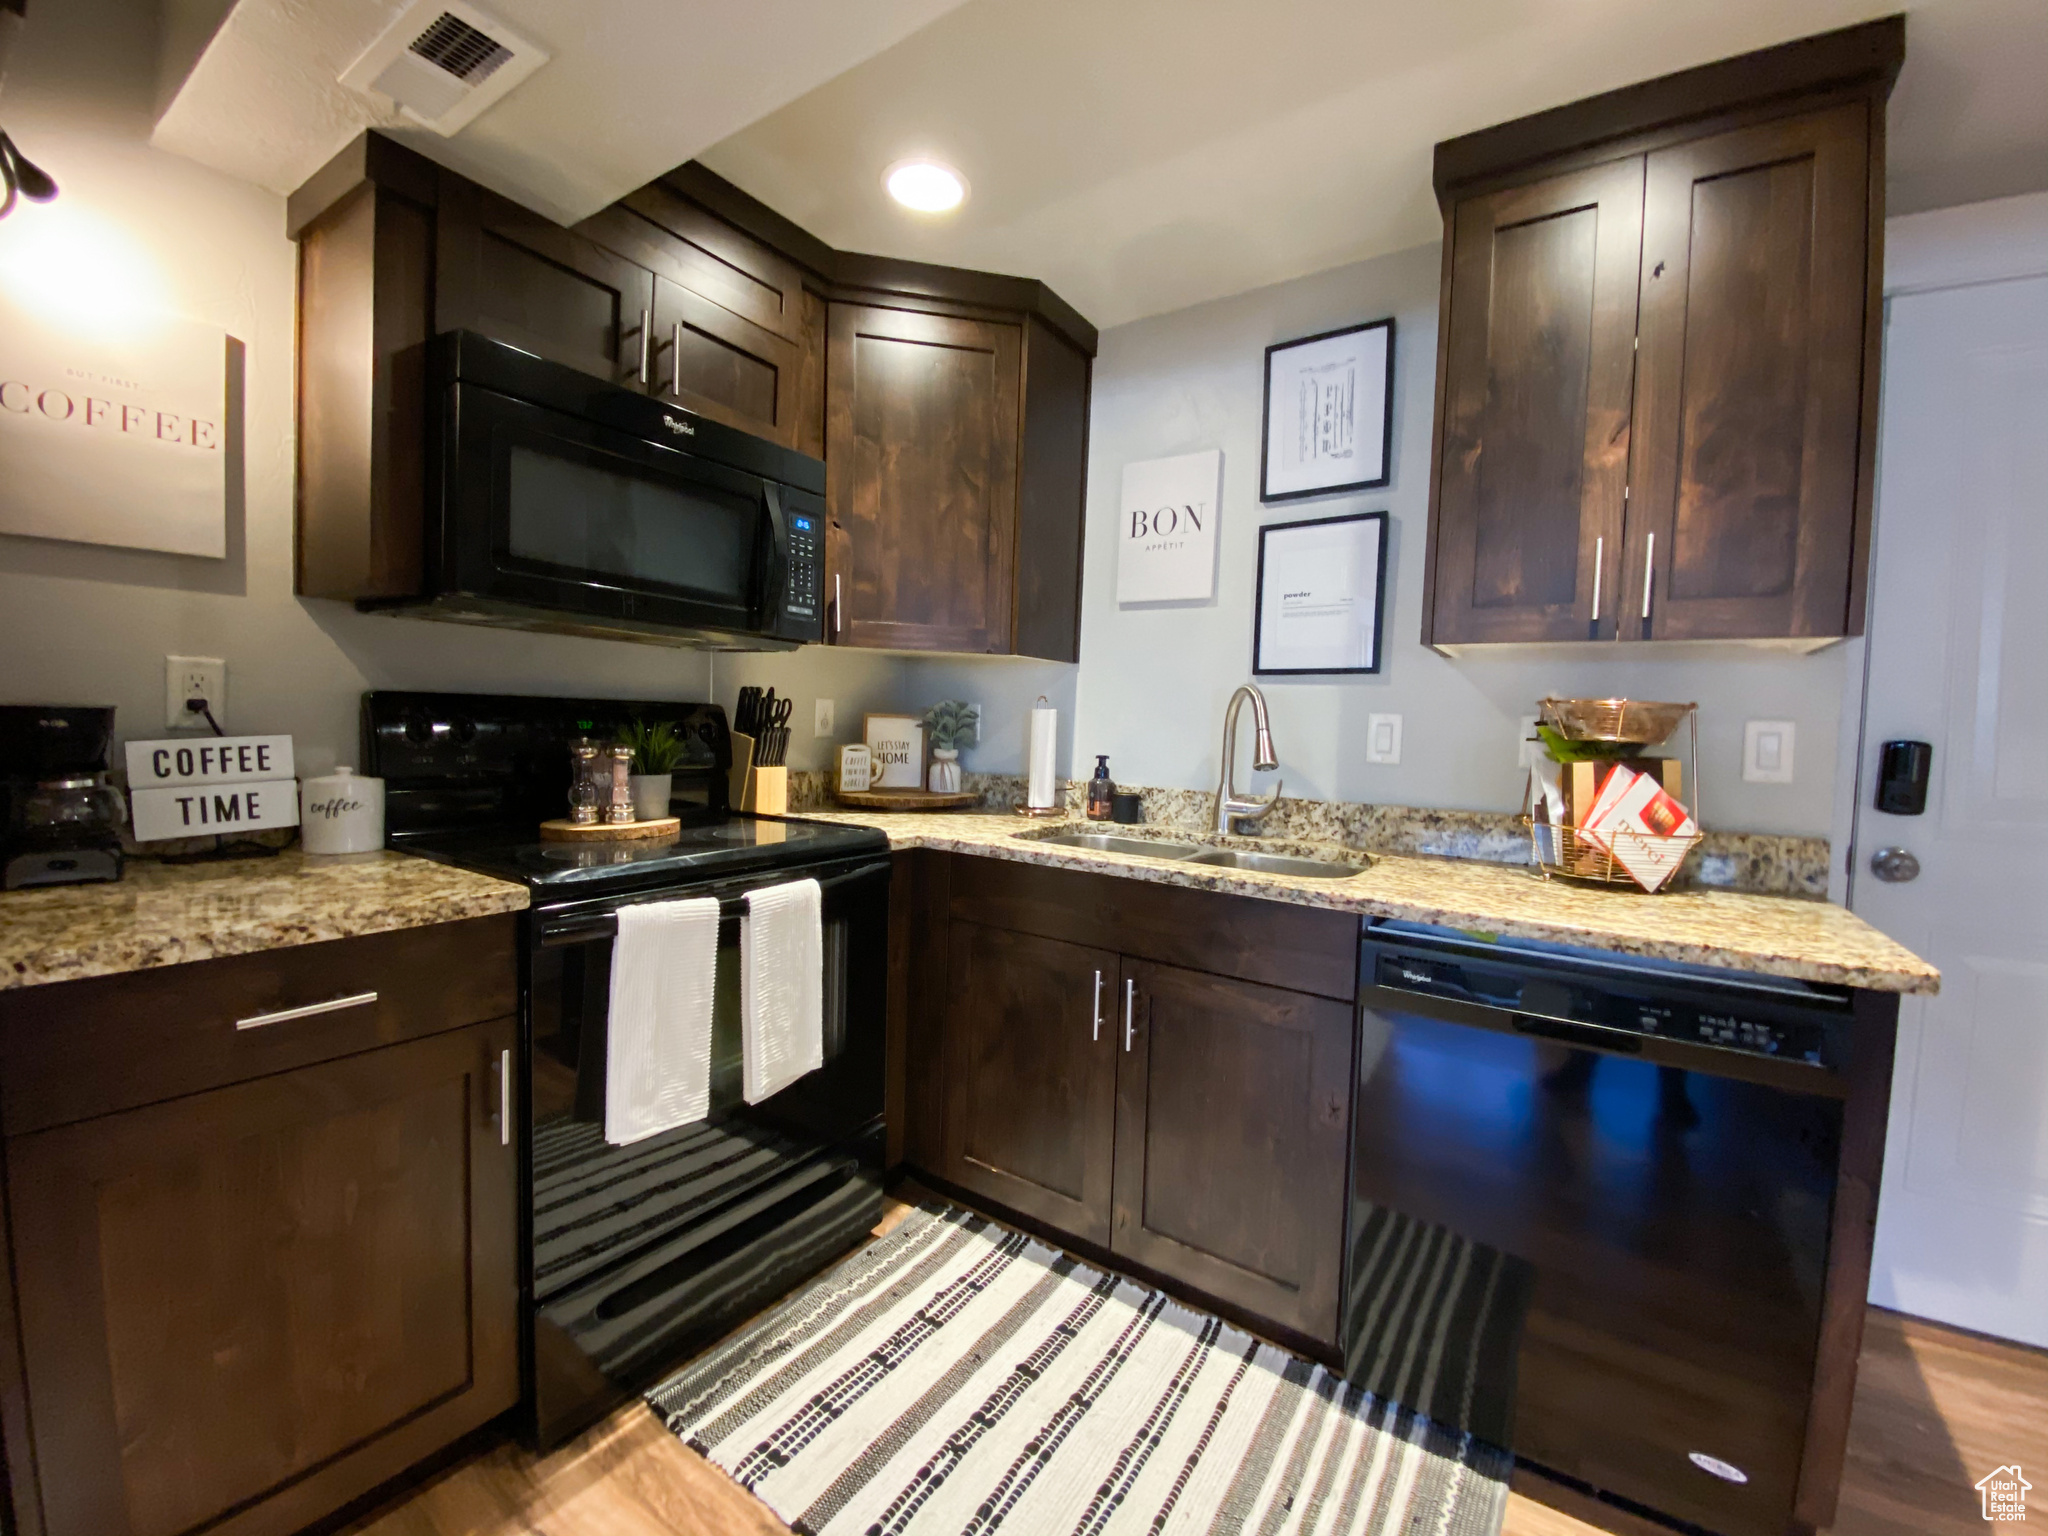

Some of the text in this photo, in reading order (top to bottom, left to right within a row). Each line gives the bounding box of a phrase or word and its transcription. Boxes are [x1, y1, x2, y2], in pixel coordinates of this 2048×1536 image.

[66, 368, 94, 380] BUT
[0, 380, 217, 450] COFFEE
[663, 415, 694, 436] Whirlpool
[1127, 502, 1207, 540] BON
[1283, 591, 1311, 600] powder
[895, 741, 910, 751] STAY
[153, 744, 272, 778] COFFEE
[878, 752, 910, 764] HOME
[175, 792, 262, 825] TIME
[310, 798, 364, 819] coffee
[1618, 818, 1665, 865] merci
[1402, 969, 1432, 984] Whirlpool
